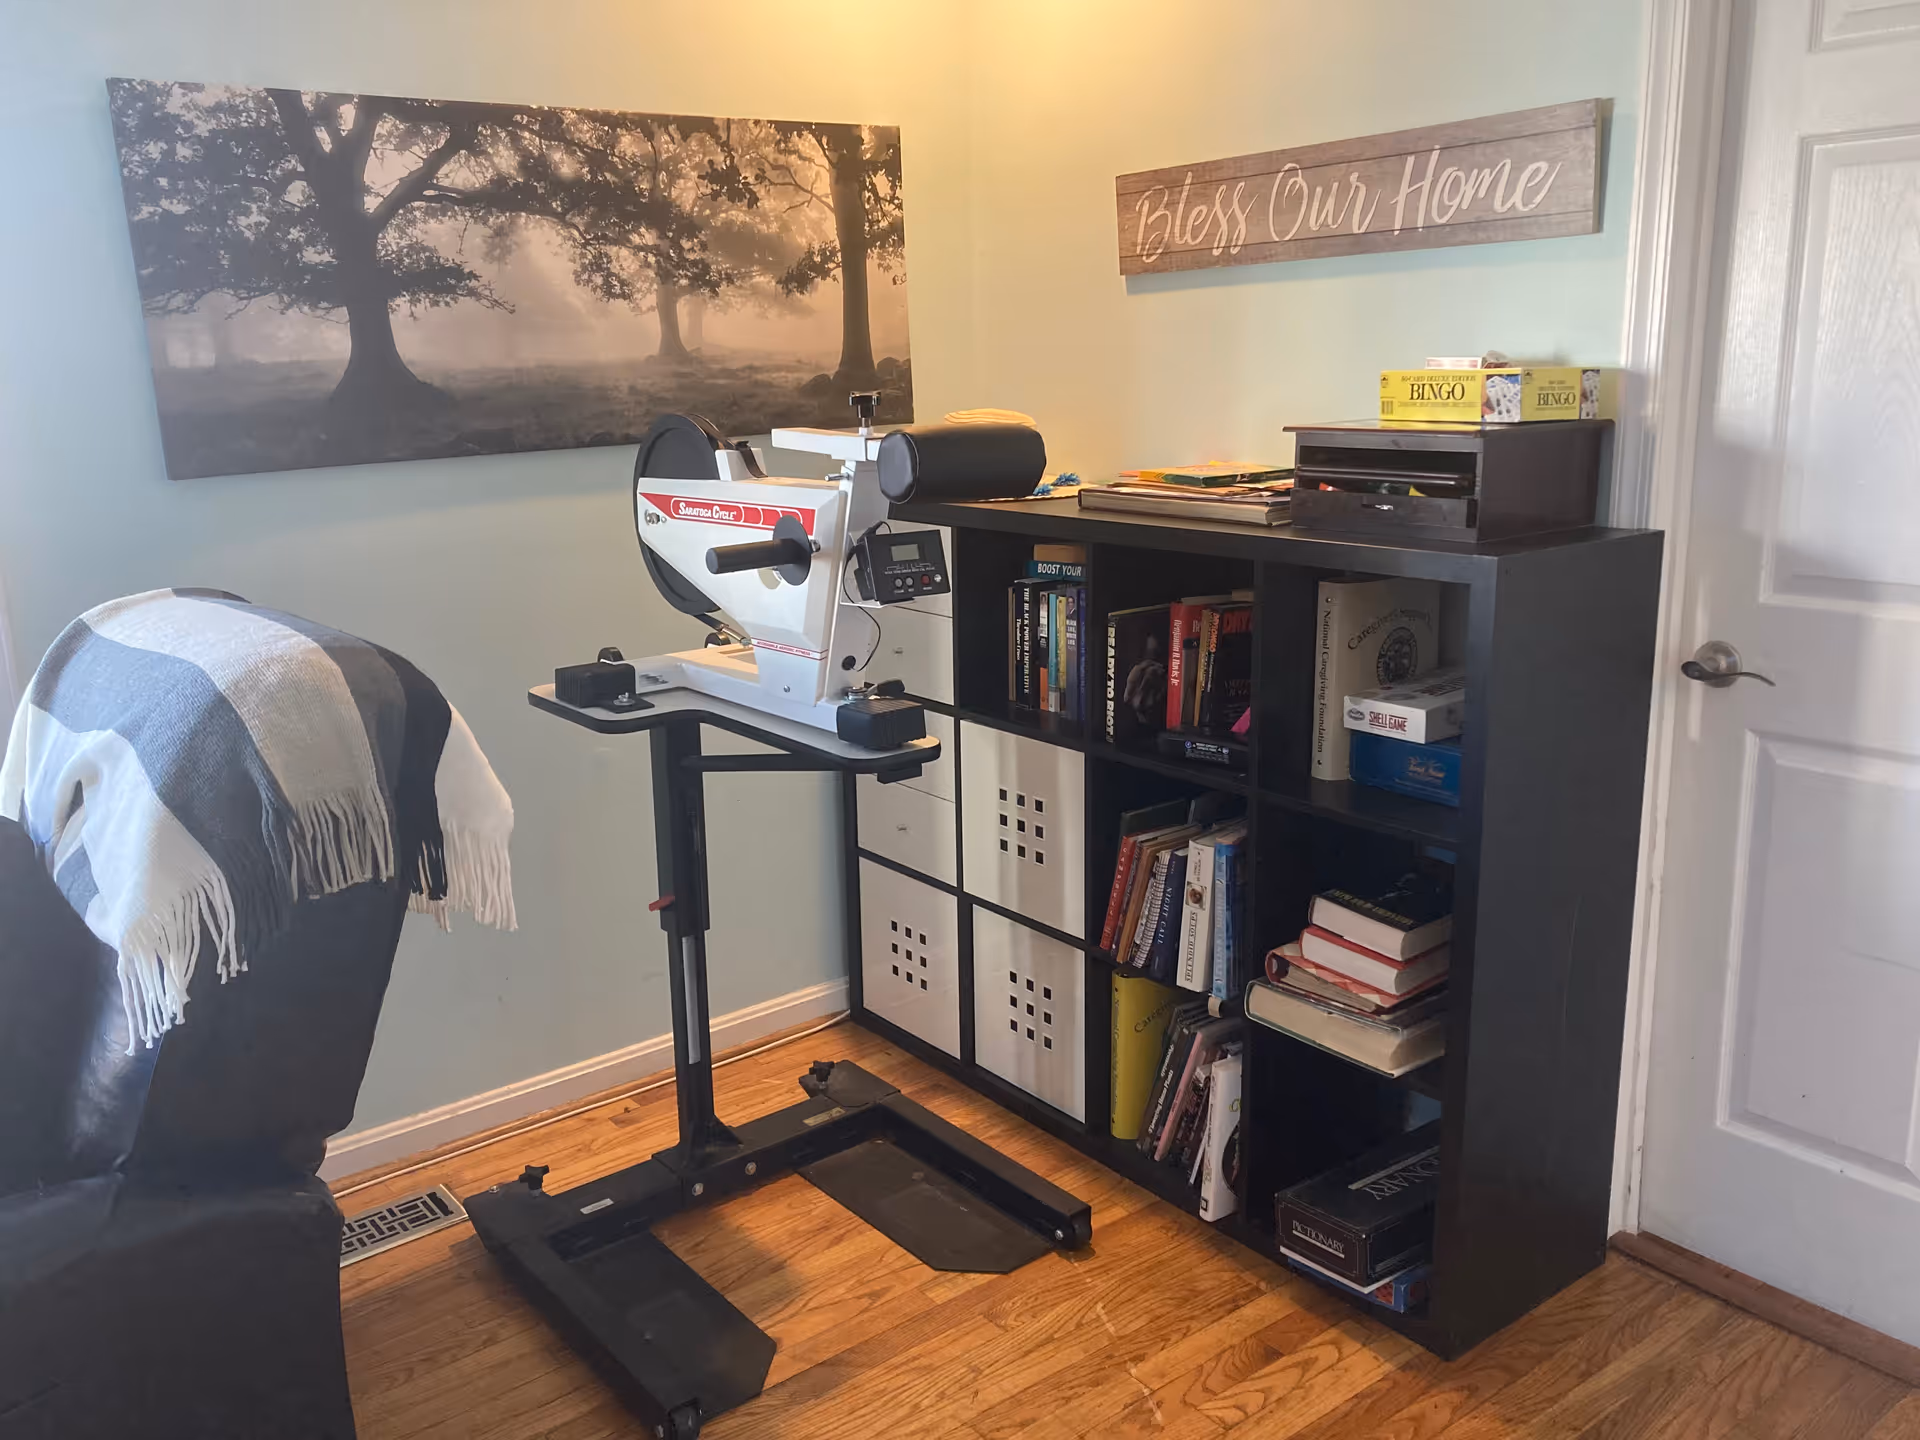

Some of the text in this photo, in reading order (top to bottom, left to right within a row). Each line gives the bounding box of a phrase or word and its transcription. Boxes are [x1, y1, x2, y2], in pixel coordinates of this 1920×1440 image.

[1135, 144, 1564, 264] Bless Our Home
[1409, 382, 1465, 401] BINGO
[1537, 392, 1576, 407] BINGO
[1037, 563, 1082, 577] BOOST YOUR
[1106, 626, 1115, 736] READY TO RIOT
[1317, 610, 1331, 753] National Caregiving Foundation
[1369, 711, 1387, 725] SHELL
[1388, 717, 1408, 732] GAME
[1156, 886, 1173, 945] NIGHT CALL
[1292, 1219, 1345, 1253] PICTIONARY
